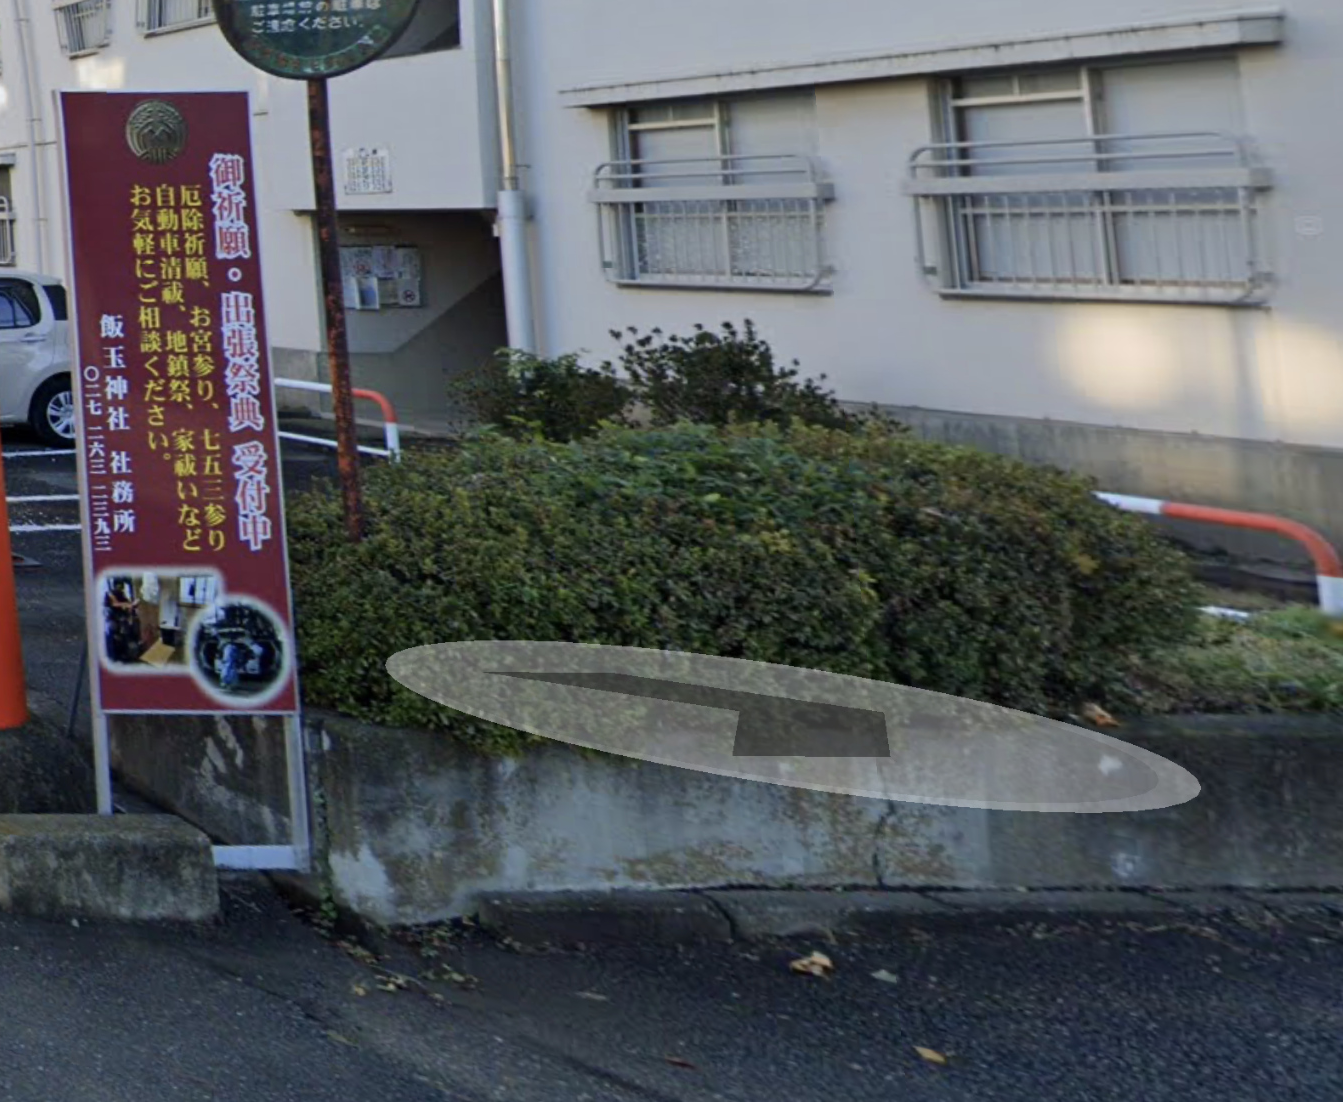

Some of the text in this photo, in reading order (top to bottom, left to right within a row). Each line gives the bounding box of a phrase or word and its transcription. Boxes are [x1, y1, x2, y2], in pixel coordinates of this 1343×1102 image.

[100, 314, 136, 533] 飯玉神社 社務所
[130, 184, 171, 460] お気軽にご相談ください。
[232, 440, 272, 551] 受付中
